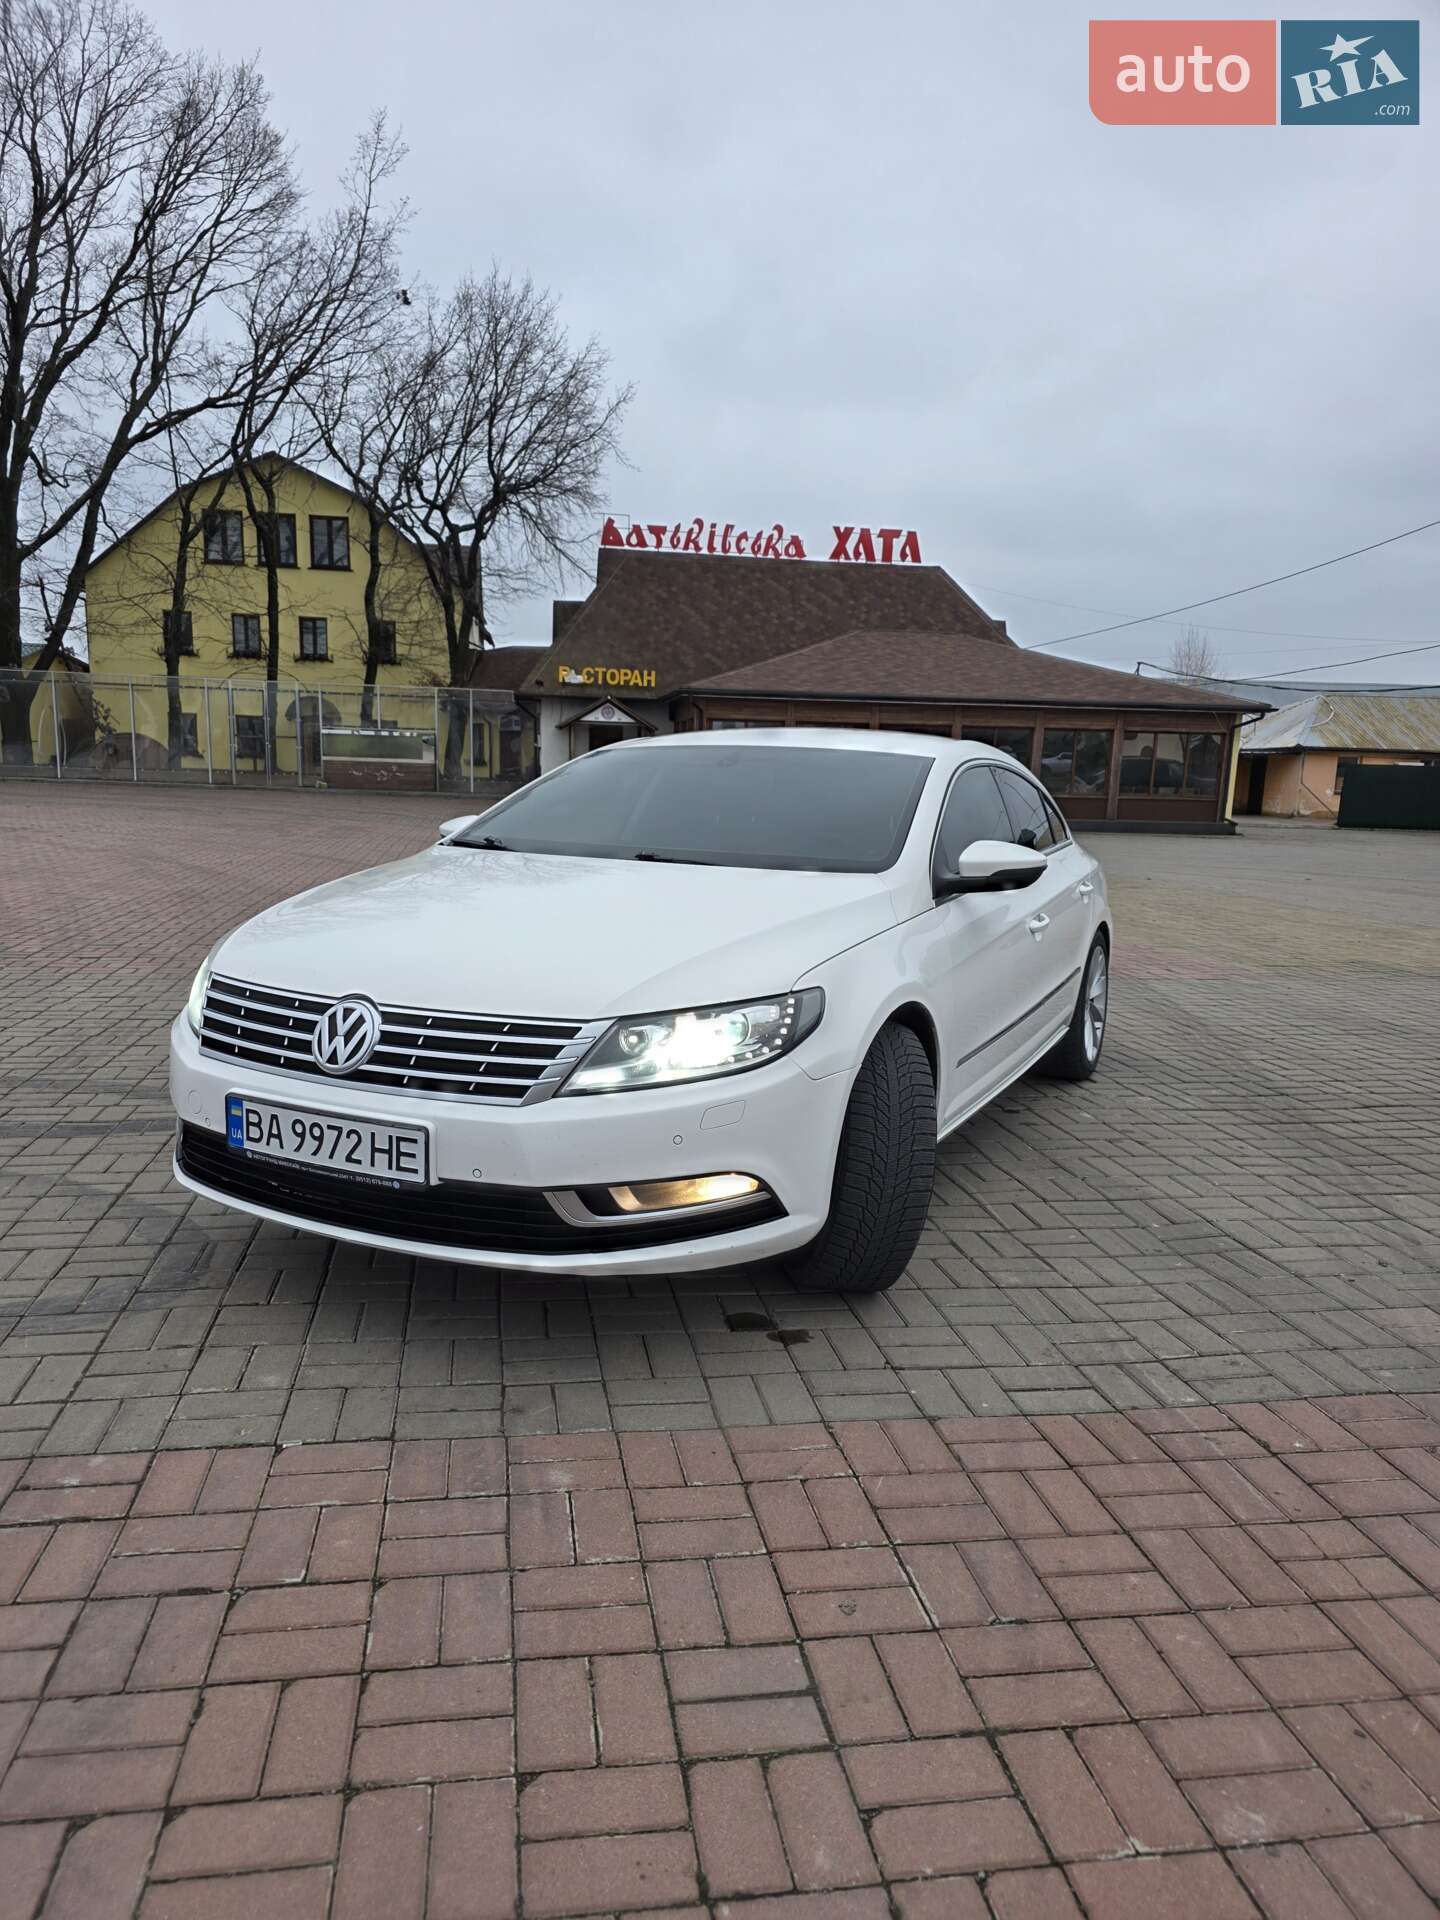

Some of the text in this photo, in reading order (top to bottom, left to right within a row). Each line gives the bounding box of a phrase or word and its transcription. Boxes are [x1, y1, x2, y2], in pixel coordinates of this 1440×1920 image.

[828, 525, 922, 564] ХАТА
[559, 665, 656, 688] РСТОРАН
[231, 1127, 243, 1140] UA
[245, 1108, 419, 1174] BA 9972 HE
